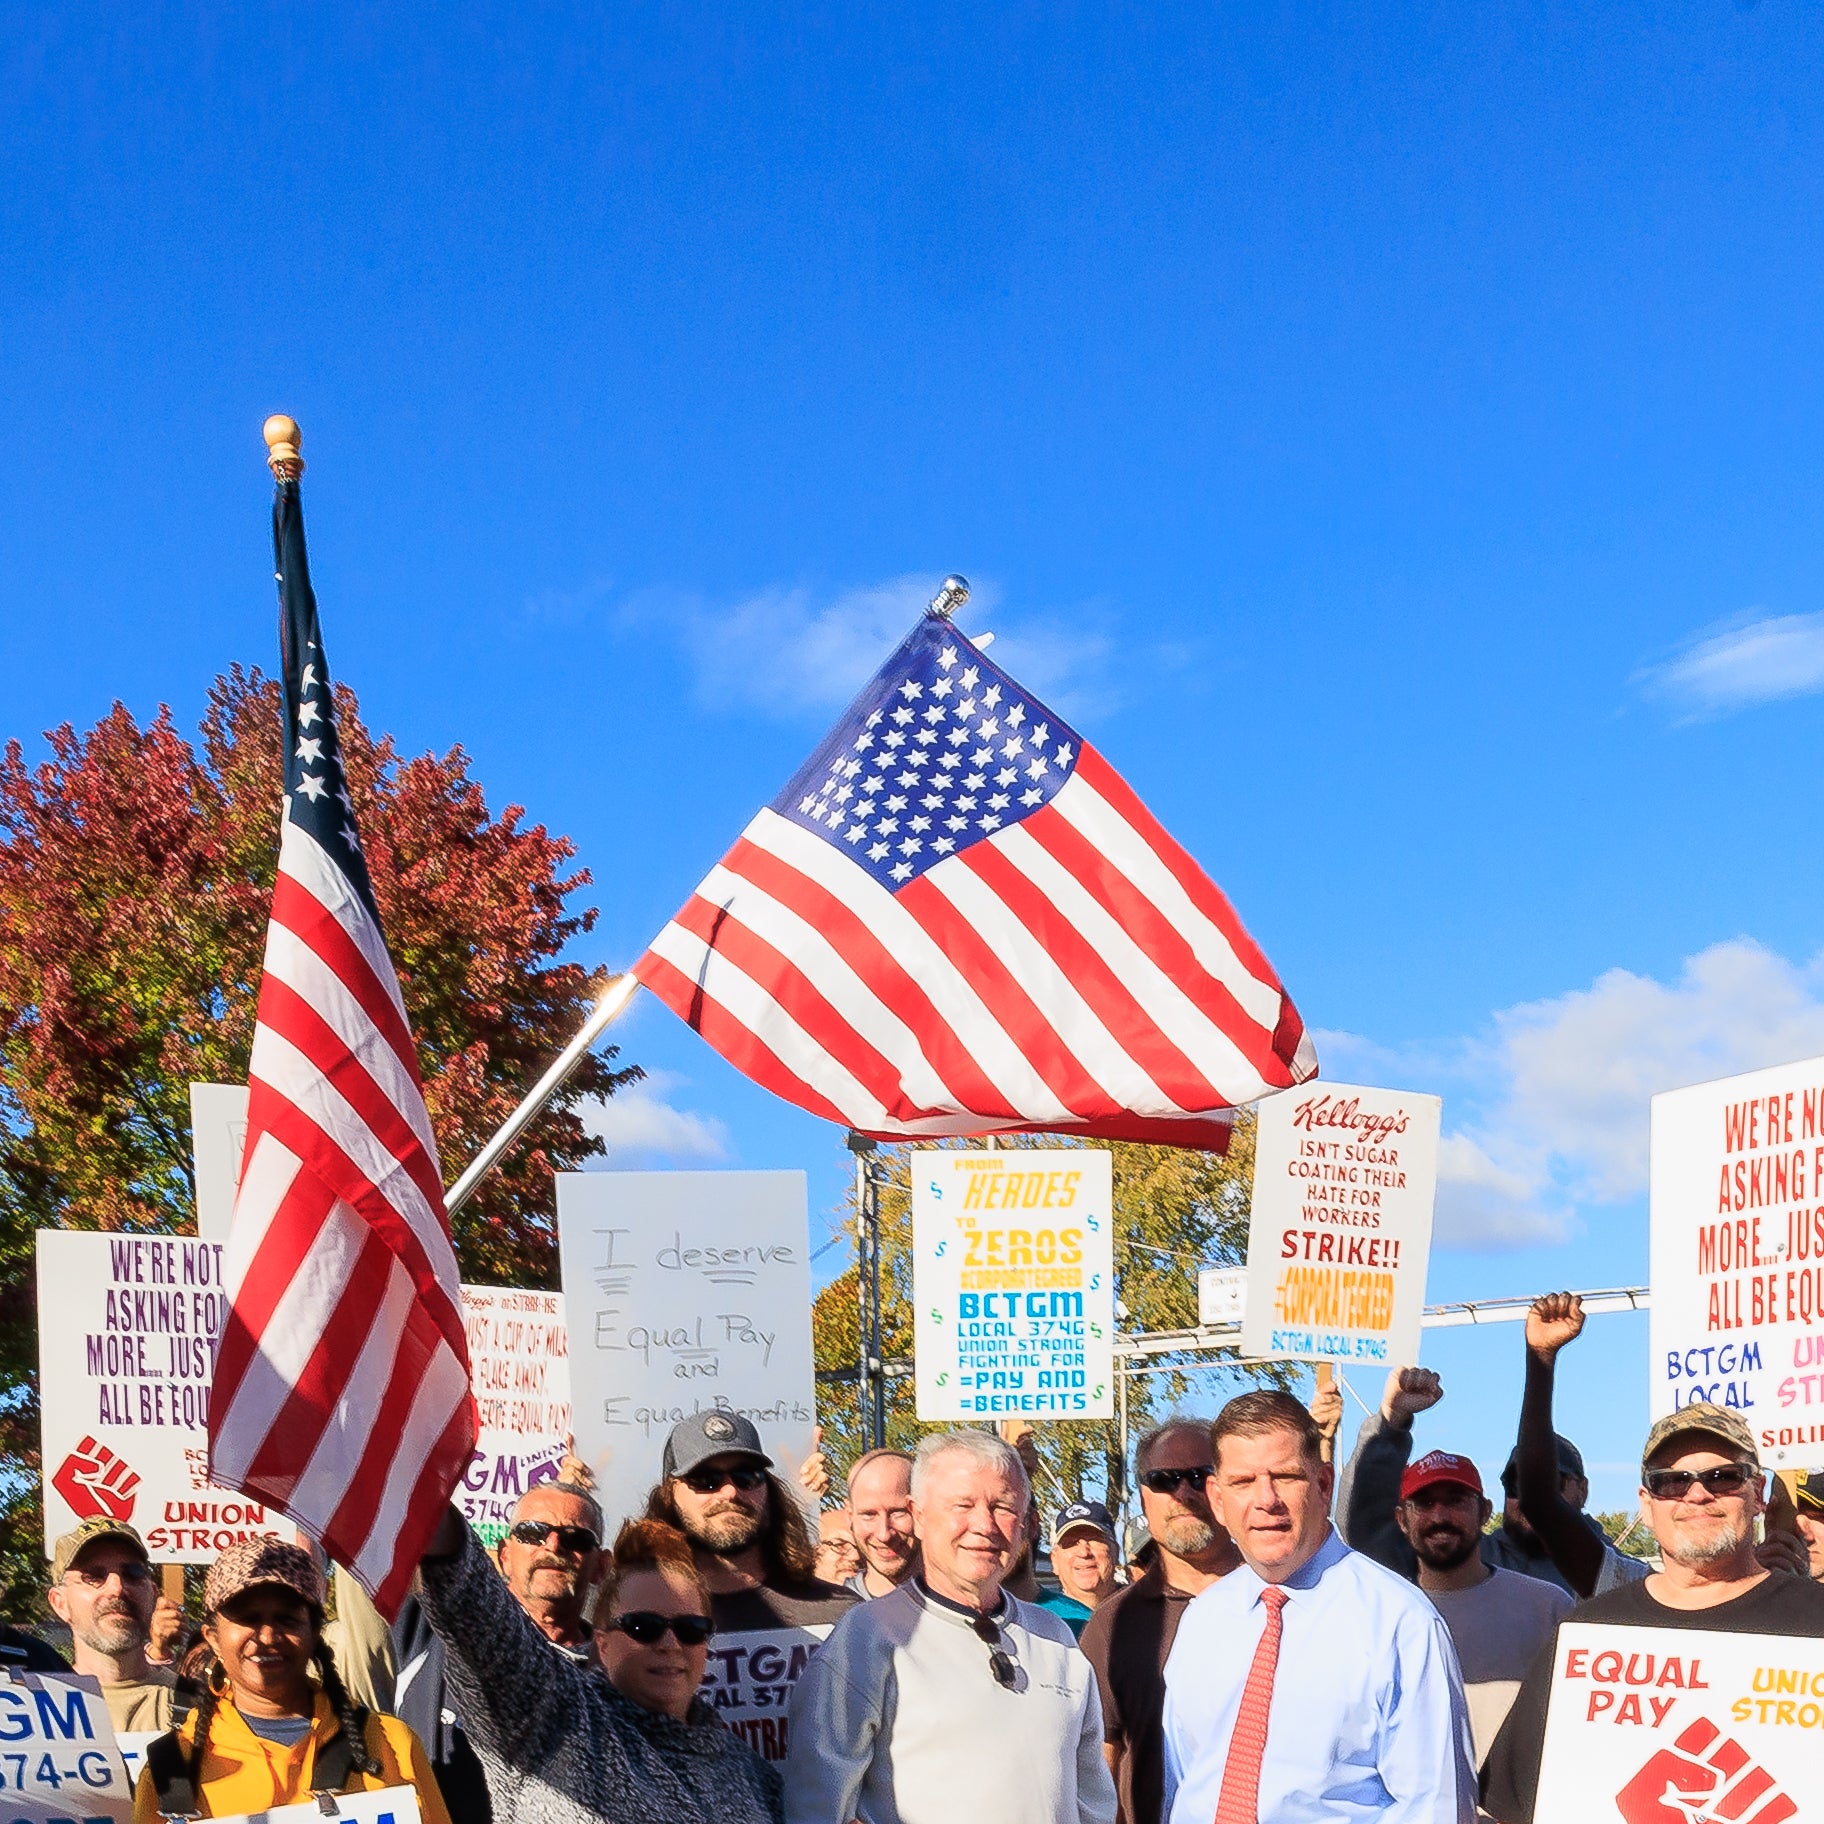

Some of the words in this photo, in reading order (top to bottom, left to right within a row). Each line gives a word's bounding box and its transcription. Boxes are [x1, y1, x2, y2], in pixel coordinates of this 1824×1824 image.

[1293, 1095, 1410, 1144] Kellogg's
[1725, 1092, 1793, 1153] WE'RE
[954, 1160, 1003, 1170] FROM
[1300, 1139, 1340, 1159] ISN'T
[1345, 1145, 1398, 1166] SUGAR
[963, 1171, 1082, 1209] HEROES
[1288, 1161, 1358, 1183] COATING
[1364, 1168, 1407, 1188] THEIR
[1718, 1150, 1805, 1214] ASKING
[1307, 1184, 1346, 1203] HATE
[1351, 1189, 1381, 1207] FOR
[955, 1217, 975, 1228] TO
[1302, 1205, 1381, 1228] WORKERS
[110, 1239, 176, 1284] WE'RE
[182, 1243, 223, 1286] NOT
[592, 1229, 638, 1271] I
[656, 1230, 797, 1270] deserve
[964, 1229, 1083, 1266] ZEROS
[1281, 1229, 1400, 1269] STRIKE!!
[106, 1289, 185, 1334] ASKING
[193, 1292, 225, 1335] FO
[960, 1291, 1083, 1319] BCTGM
[1708, 1279, 1743, 1331] ALL
[1752, 1274, 1777, 1326] BE
[595, 1309, 702, 1366] Equal
[716, 1314, 776, 1367] Pay
[958, 1322, 1016, 1337] LOCAL
[1028, 1321, 1084, 1336] 374G
[958, 1340, 1008, 1352] UNION
[1018, 1338, 1084, 1351] STRONG
[1271, 1330, 1313, 1353] BCTGM
[1317, 1334, 1352, 1357] LOCAL
[1355, 1337, 1388, 1360] 374G
[673, 1357, 719, 1379] and
[959, 1354, 1040, 1368] FIGHTING
[1051, 1353, 1084, 1366] FOR
[1667, 1341, 1763, 1380] BCTGM
[960, 1371, 1023, 1389] =PAY
[1038, 1370, 1085, 1388] AND
[99, 1384, 133, 1425] ALL
[140, 1384, 164, 1426] BE
[171, 1384, 211, 1430] EQU
[960, 1393, 1086, 1412] =BENEFITS
[164, 1502, 264, 1525] UNION
[1565, 1648, 1711, 1691] EQUAL
[1586, 1690, 1677, 1730] PAY
